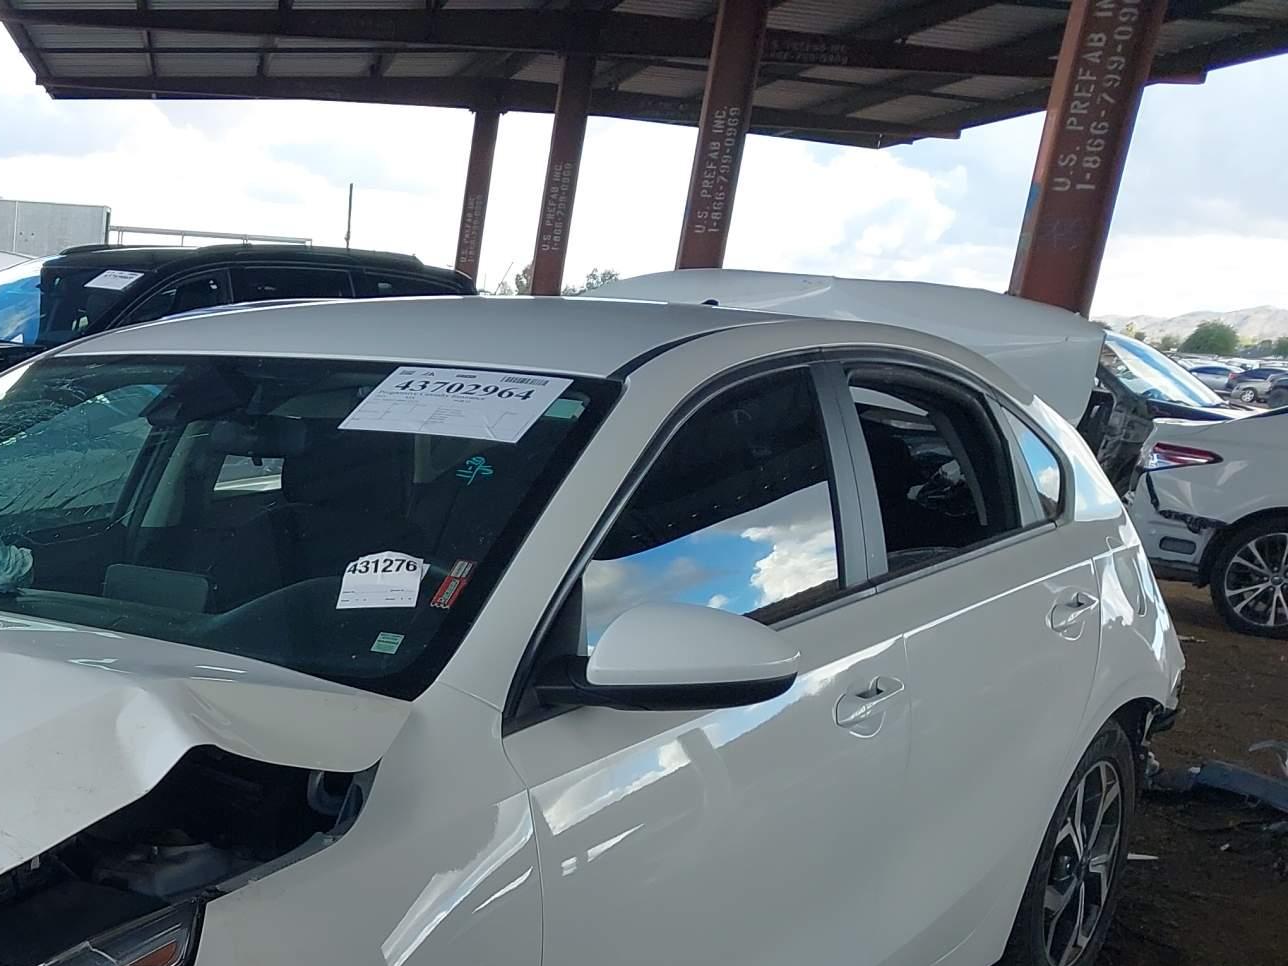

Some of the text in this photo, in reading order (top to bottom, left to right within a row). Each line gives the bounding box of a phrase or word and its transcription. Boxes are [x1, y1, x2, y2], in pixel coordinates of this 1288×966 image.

[1066, 32, 1106, 130] PREFAB
[1076, 0, 1141, 190] 1-866-799-09
[700, 141, 721, 198] PREFAB
[394, 379, 536, 401] 43702964
[347, 558, 418, 575] 431276
